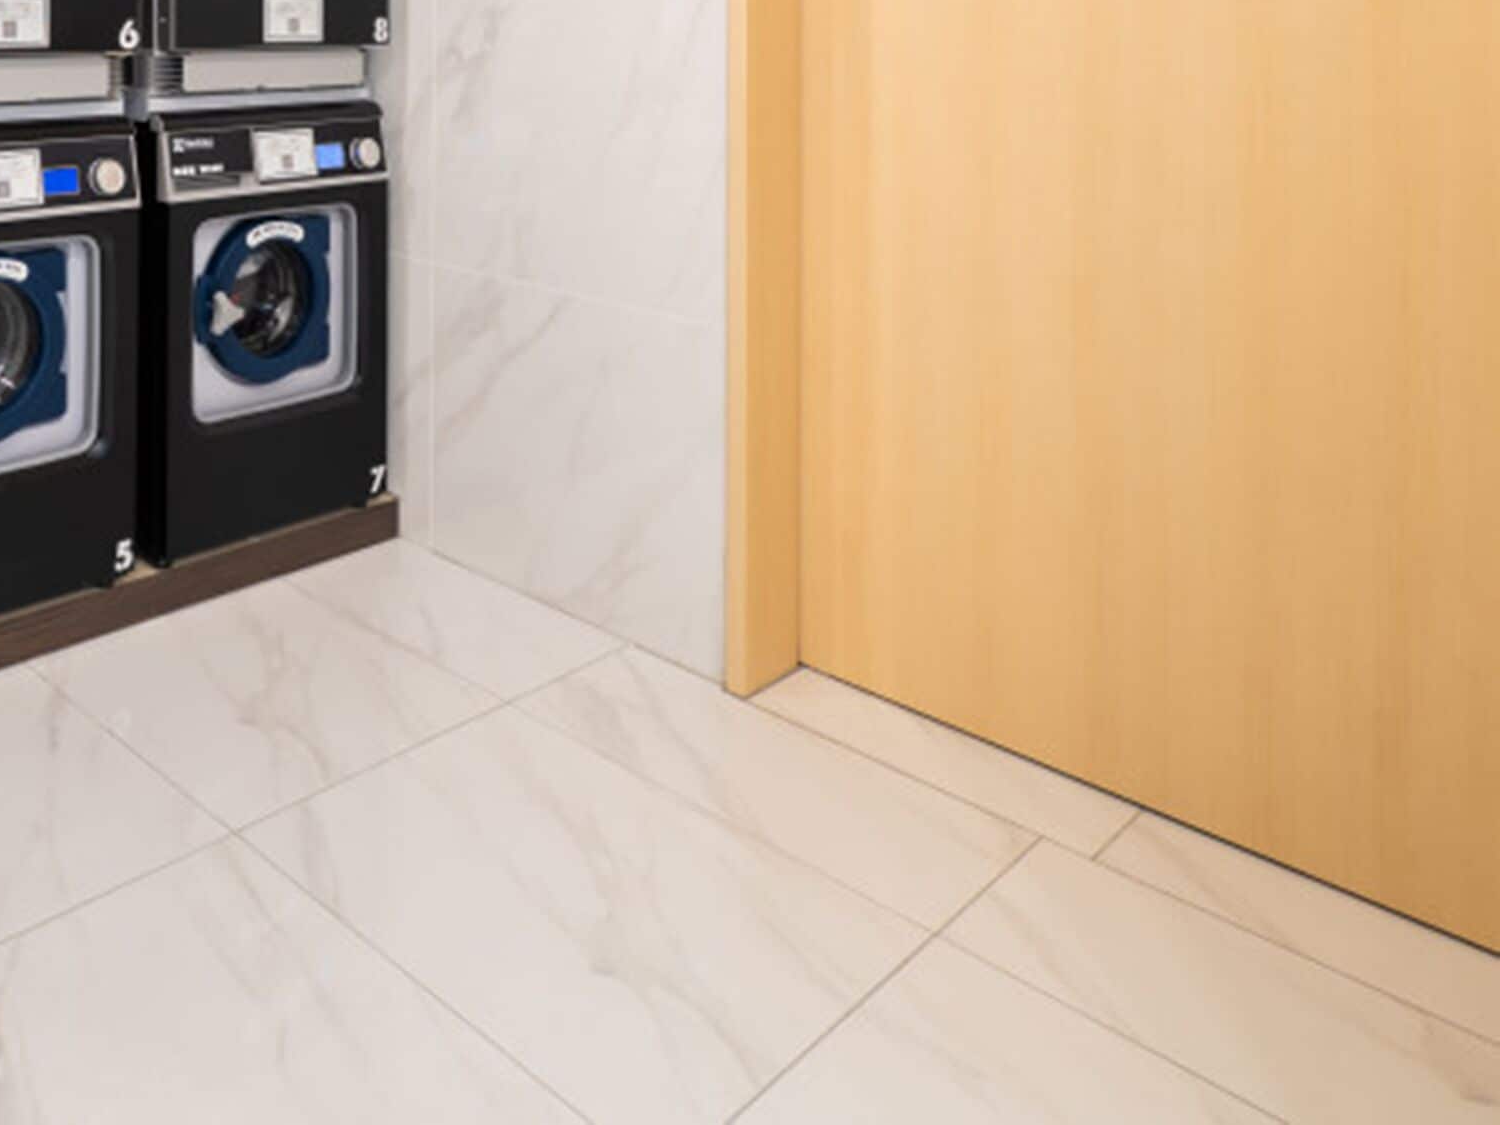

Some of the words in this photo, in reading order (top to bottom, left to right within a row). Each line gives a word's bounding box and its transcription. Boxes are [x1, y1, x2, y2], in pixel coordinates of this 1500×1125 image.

[118, 19, 141, 50] 6
[374, 16, 389, 43] 8
[369, 464, 386, 494] 7
[114, 536, 135, 573] 5
